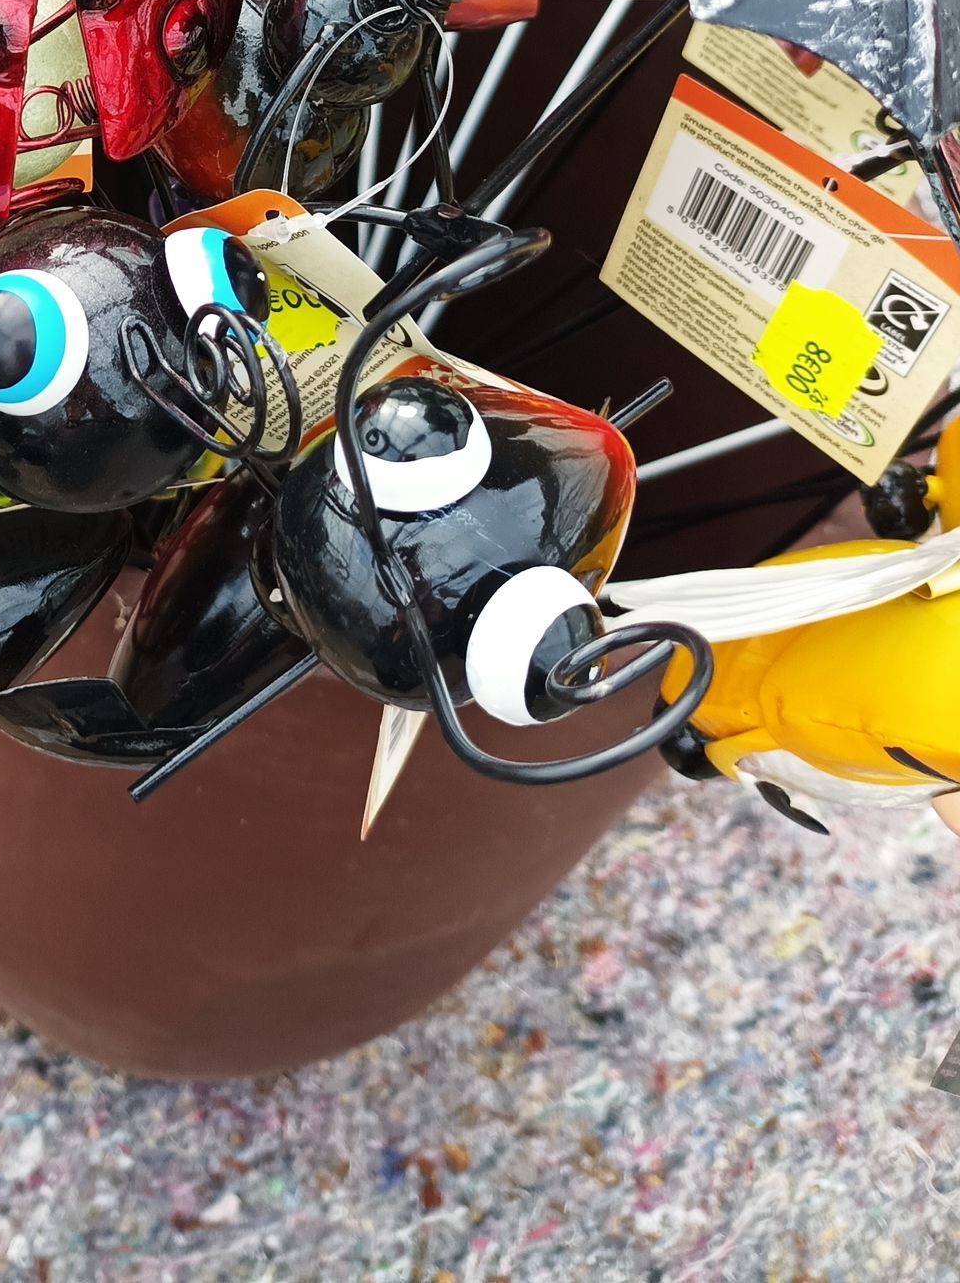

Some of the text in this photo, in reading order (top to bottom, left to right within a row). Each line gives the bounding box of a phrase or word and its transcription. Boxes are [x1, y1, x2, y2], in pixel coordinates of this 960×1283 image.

[680, 122, 696, 134] the
[696, 133, 734, 159] product
[684, 113, 712, 134] Smart
[713, 132, 748, 157] Garden
[750, 156, 791, 185] reserves
[793, 182, 810, 196] the
[835, 210, 846, 220] to
[714, 162, 803, 224] Code: 5030400
[665, 248, 682, 261] and
